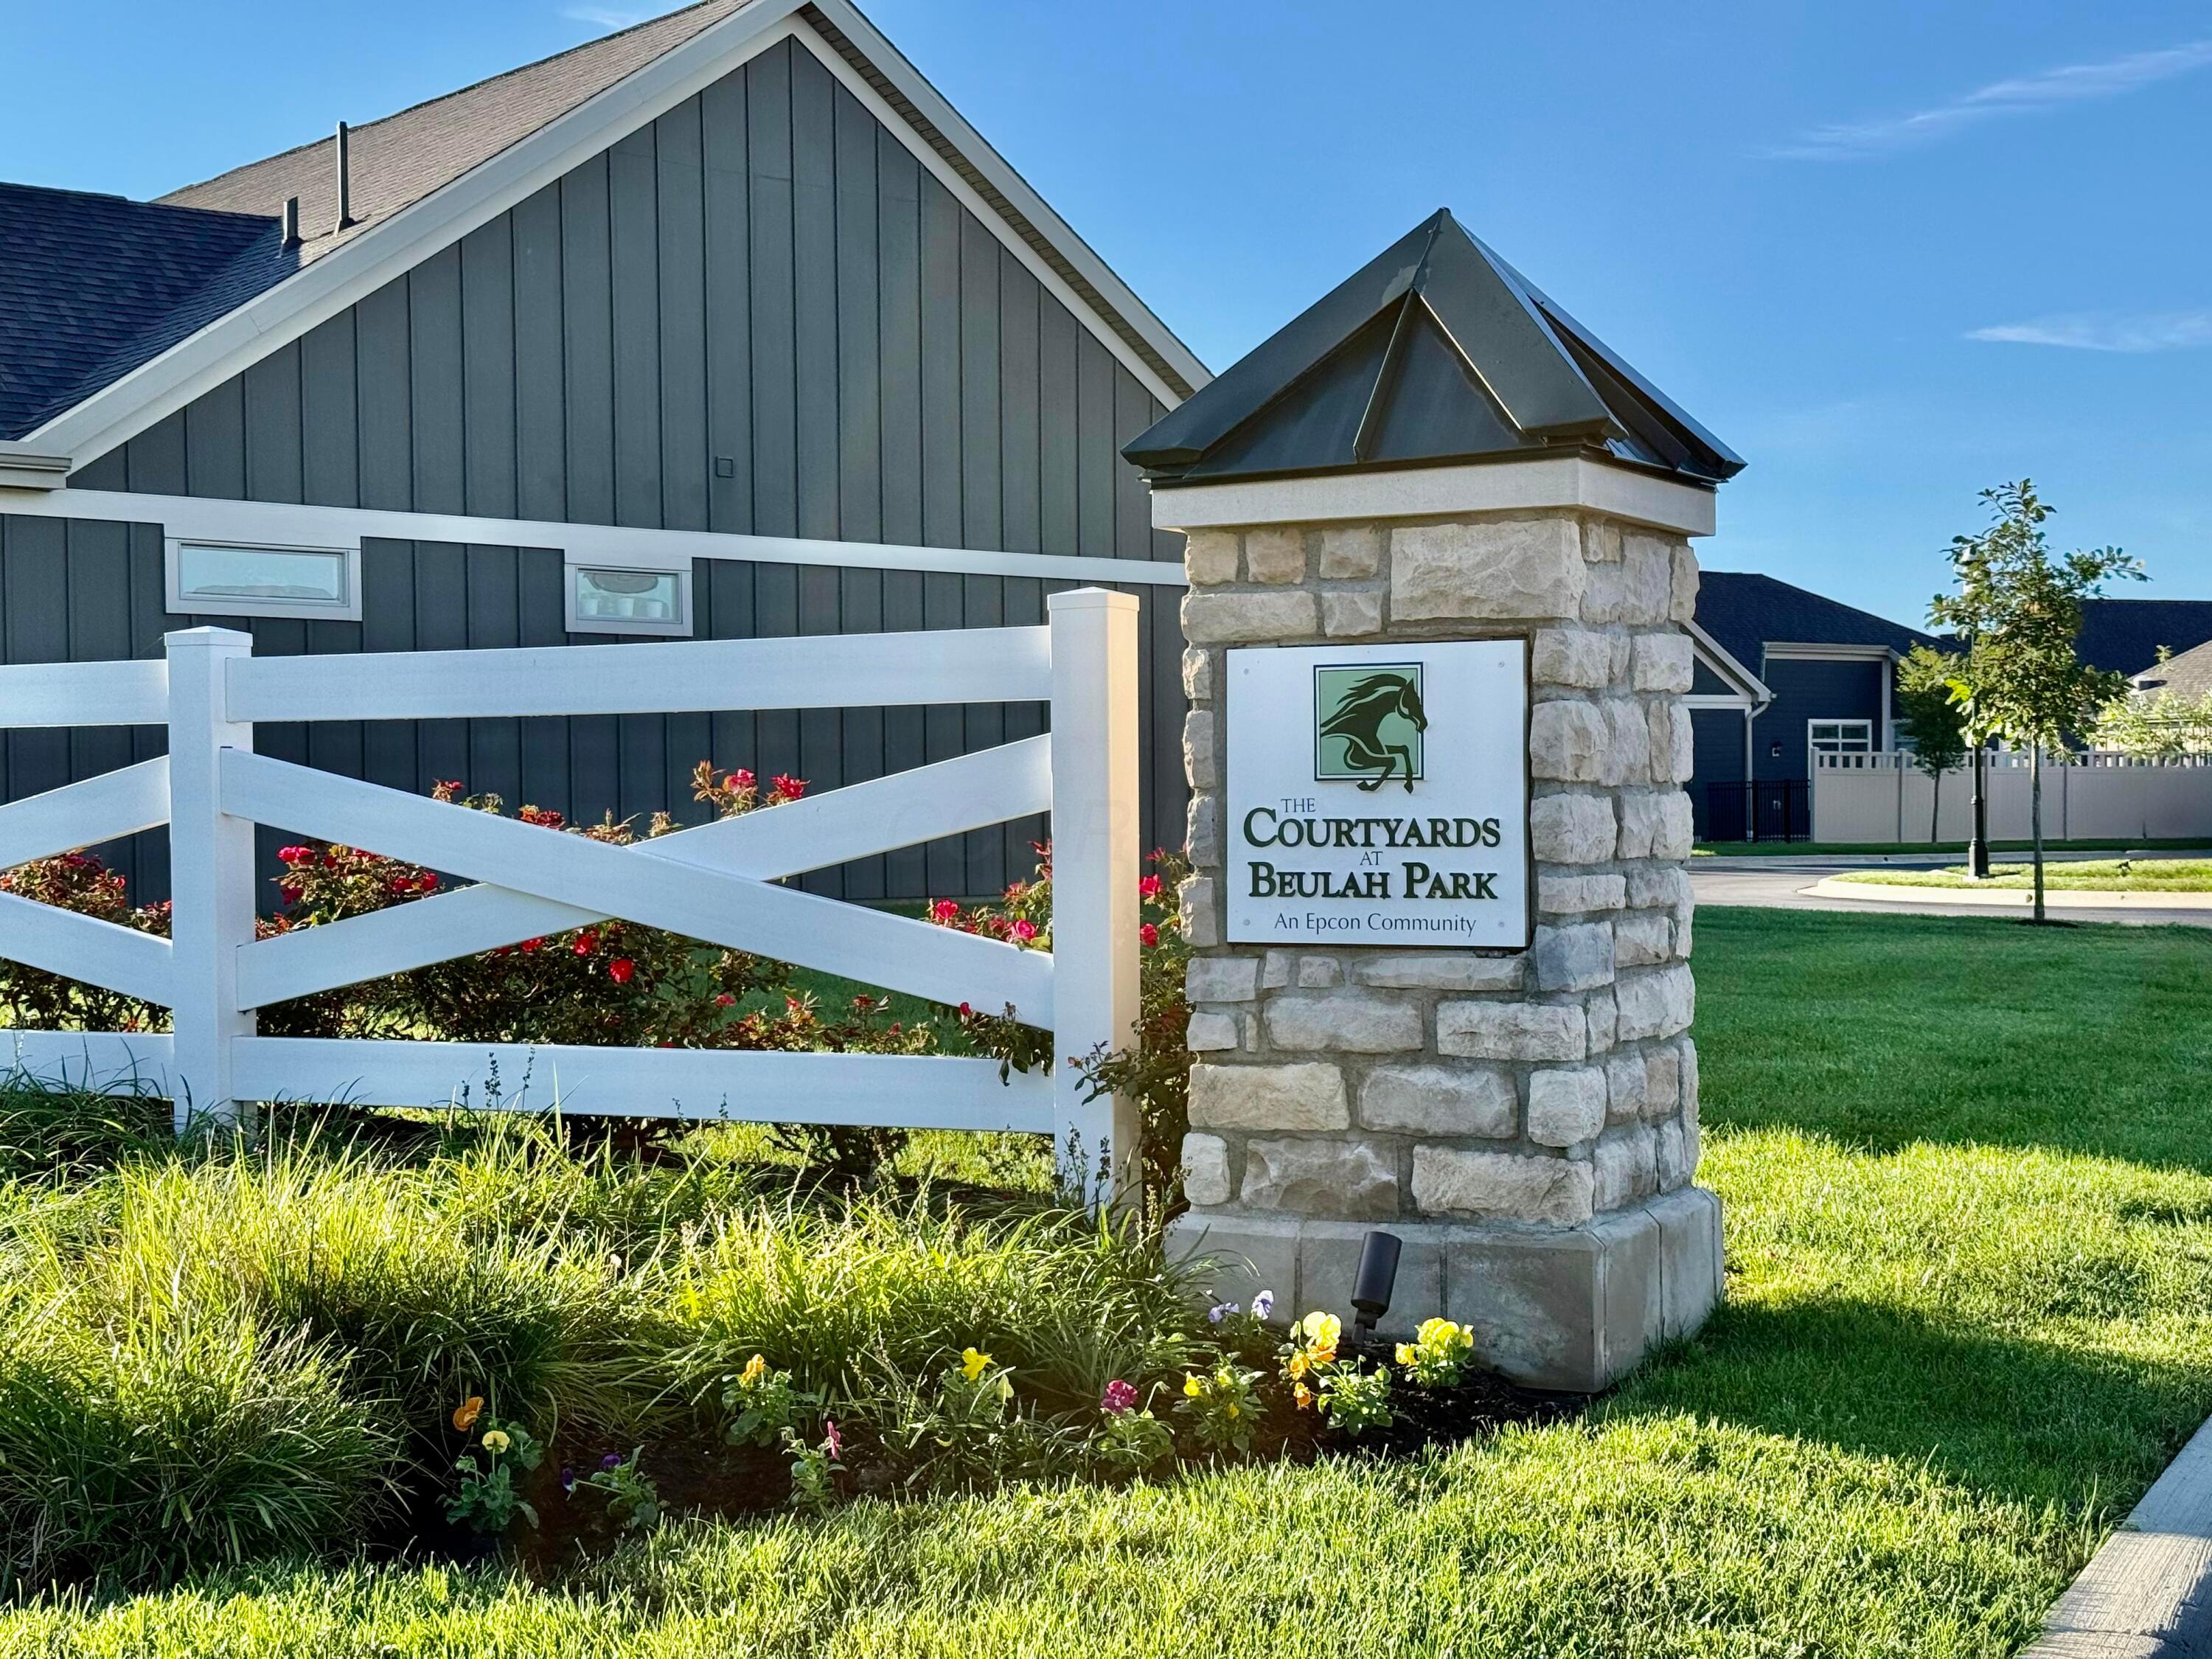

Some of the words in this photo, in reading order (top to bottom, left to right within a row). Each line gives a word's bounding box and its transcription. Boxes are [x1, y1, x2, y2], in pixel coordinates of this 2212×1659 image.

[1281, 798, 1315, 813] THE
[1243, 807, 1500, 848] COURTYARDS
[1360, 851, 1383, 866] AT
[1248, 861, 1391, 899] BEULAH
[1402, 862, 1498, 900] PARK
[1274, 913, 1298, 929] An
[1307, 913, 1360, 934] Epcon
[1368, 913, 1477, 936] Community
